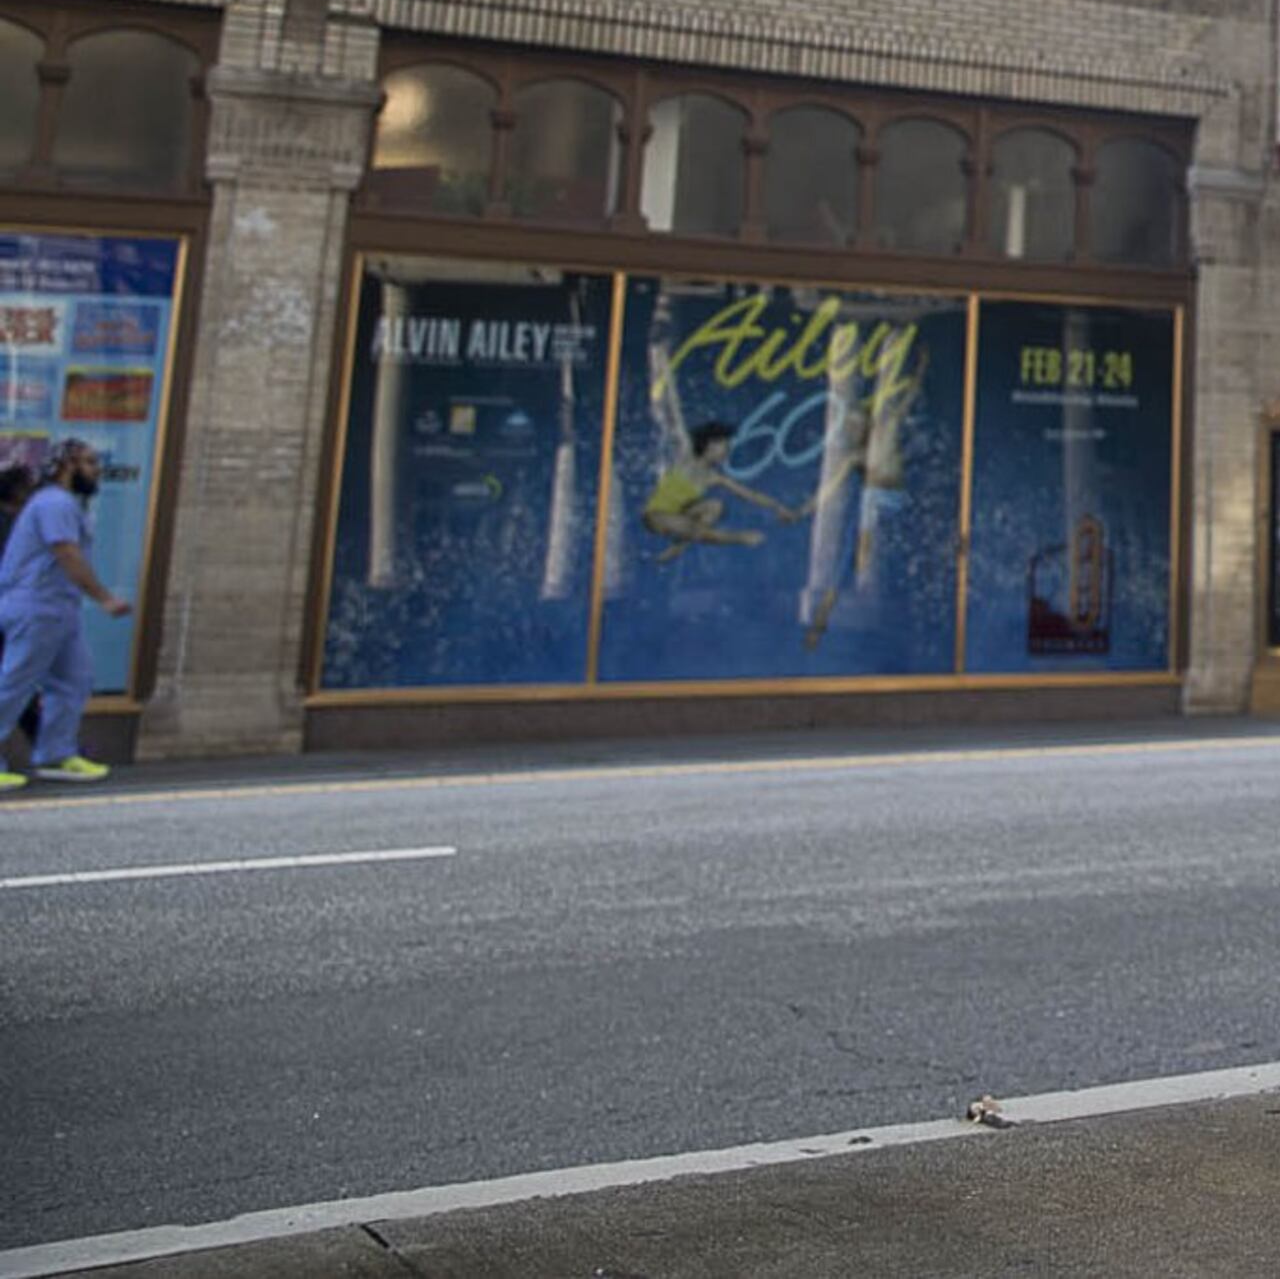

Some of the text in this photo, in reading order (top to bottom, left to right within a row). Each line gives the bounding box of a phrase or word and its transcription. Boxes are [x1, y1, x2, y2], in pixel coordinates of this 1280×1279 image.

[372, 316, 461, 359] ALVIN
[467, 319, 551, 361] AILEY
[652, 293, 918, 420] Ailey
[1020, 344, 1062, 385] FEB
[722, 391, 846, 479] 60
